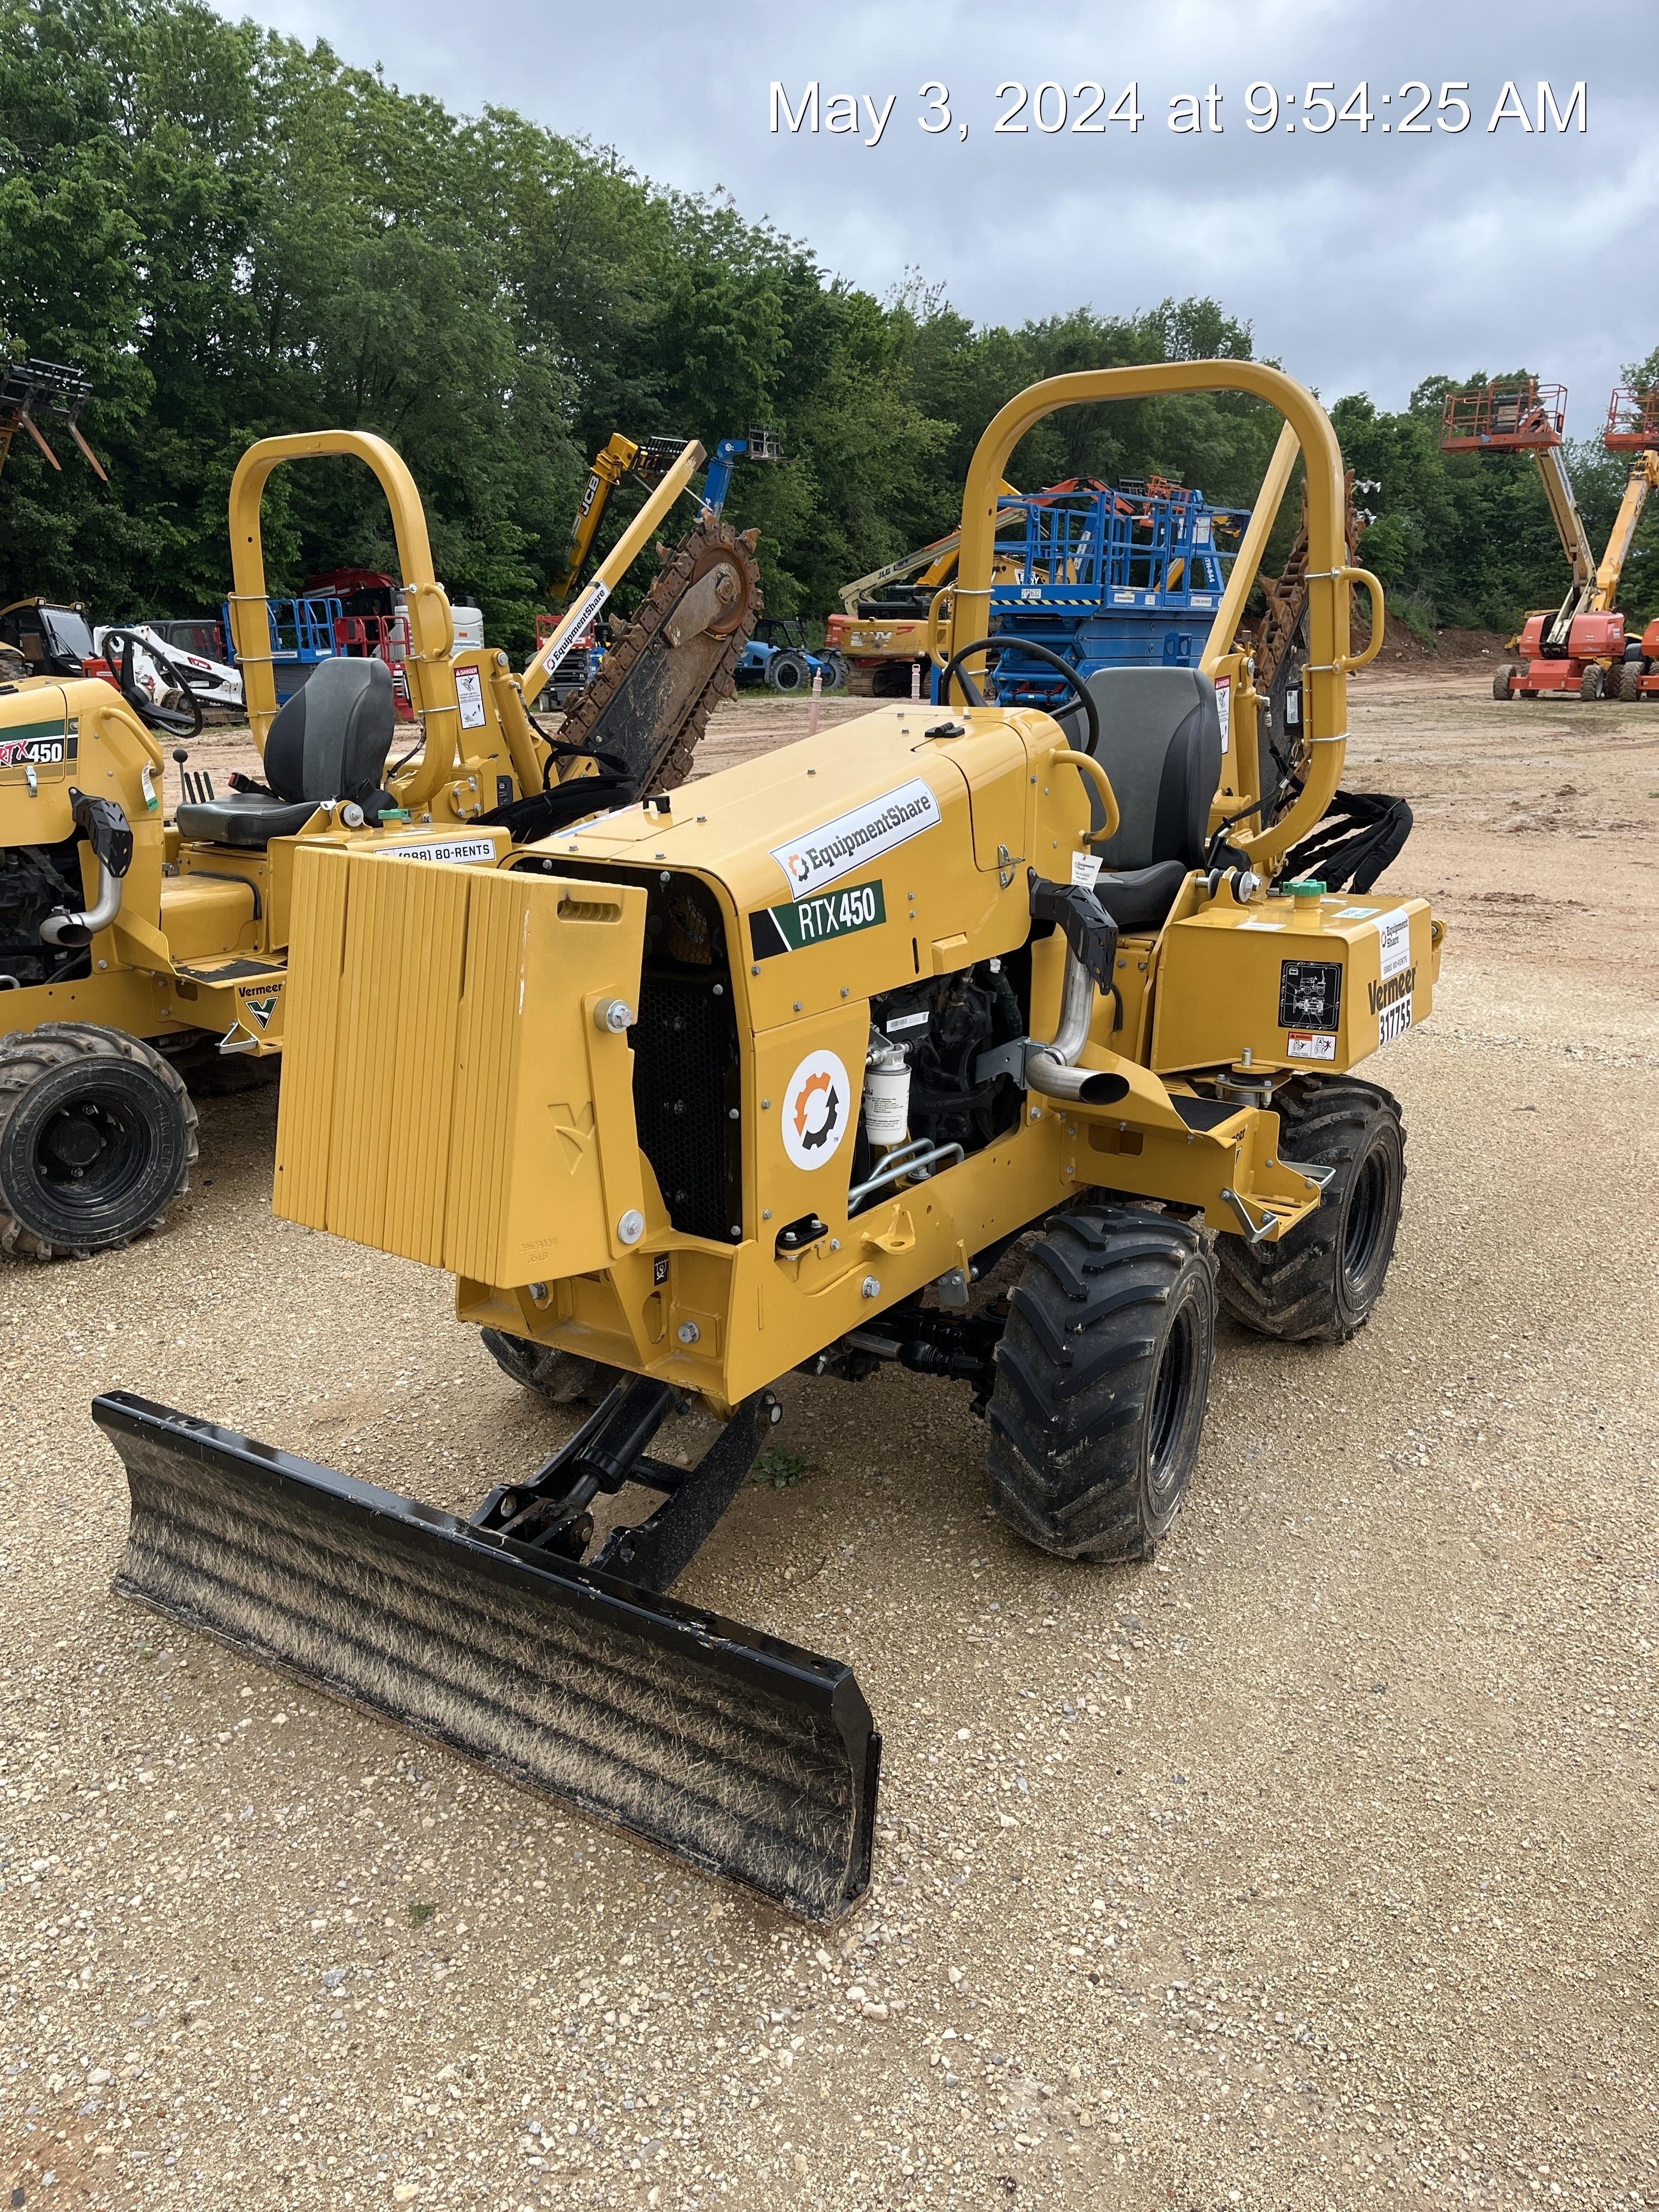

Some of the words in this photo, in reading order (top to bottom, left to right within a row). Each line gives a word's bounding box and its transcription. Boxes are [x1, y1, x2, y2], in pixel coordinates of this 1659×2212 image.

[582, 475, 600, 516] JCB
[878, 567, 891, 579] JLG
[553, 589, 606, 662] EquipmentShare
[435, 844, 490, 860] 80-RENTS
[804, 795, 932, 871] EquipmentShare
[798, 887, 876, 941] RTX450
[1386, 918, 1408, 936] Equipment
[1387, 935, 1399, 949] Share
[239, 983, 283, 998] Vermeer
[1368, 967, 1416, 1017] Vermeer
[1380, 998, 1411, 1046] 317755
